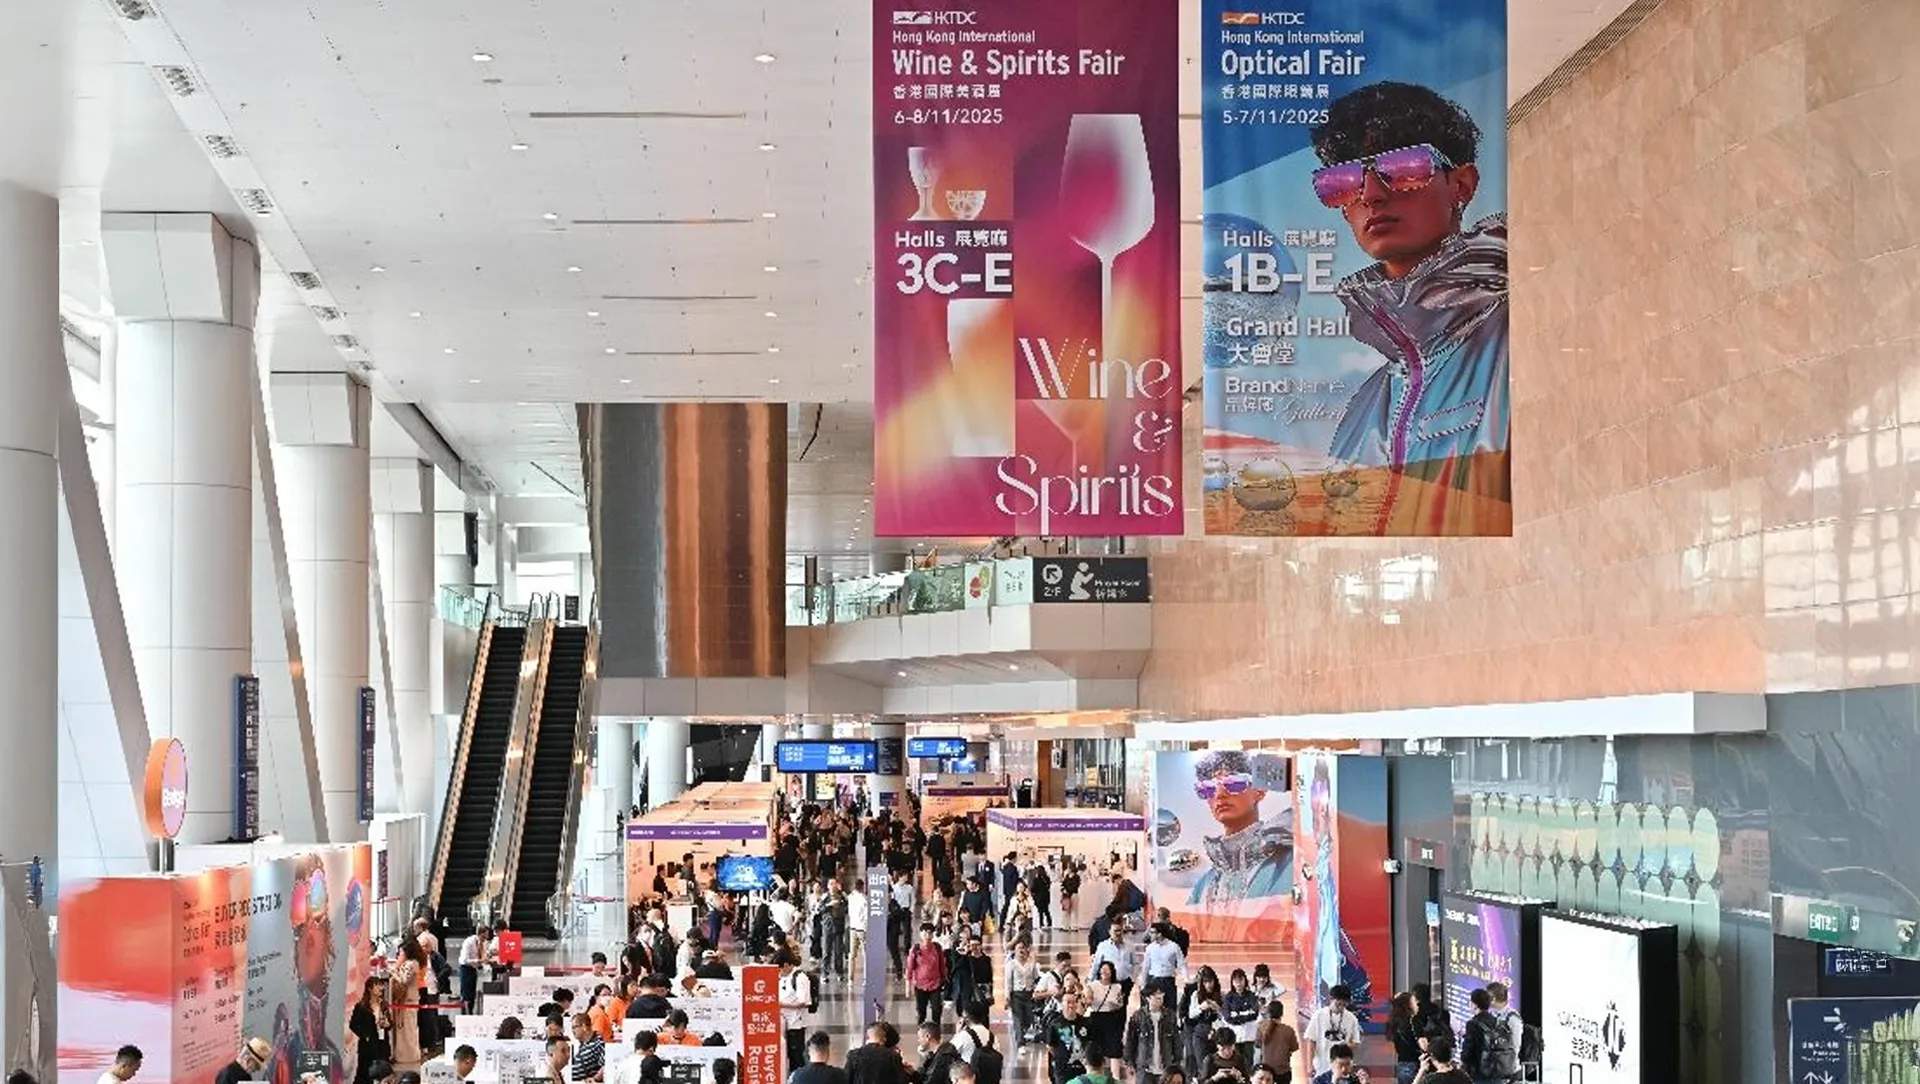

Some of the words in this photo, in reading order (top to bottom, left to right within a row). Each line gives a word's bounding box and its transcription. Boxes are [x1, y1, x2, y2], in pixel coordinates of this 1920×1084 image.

[935, 11, 976, 24] HKTDC
[1262, 13, 1304, 24] HKTDC
[893, 31, 922, 45] Hong
[927, 31, 955, 45] Kong
[959, 31, 1035, 42] International
[1222, 31, 1250, 45] Hong
[1255, 31, 1283, 45] Kong
[1288, 31, 1363, 43] International
[892, 50, 952, 74] Wine
[961, 50, 977, 74] &
[987, 50, 1069, 80] Spirits
[1080, 50, 1125, 74] Fair
[1222, 50, 1309, 80] Optical
[1320, 50, 1365, 74] Fair
[895, 109, 1002, 124] 6-8/11/2025
[1224, 109, 1328, 124] 5-7/11/2025
[896, 231, 944, 247] Halls
[1224, 229, 1273, 246] Halls
[897, 253, 1012, 293] 3C-E
[1222, 251, 1334, 294] 1B-E
[1226, 317, 1298, 338] Grand
[1306, 317, 1350, 337] Hall
[1018, 338, 1173, 399] Wine
[1130, 408, 1174, 453] &
[994, 454, 1175, 534] Spirits
[870, 889, 884, 917] Exit
[763, 1044, 778, 1084] Buye
